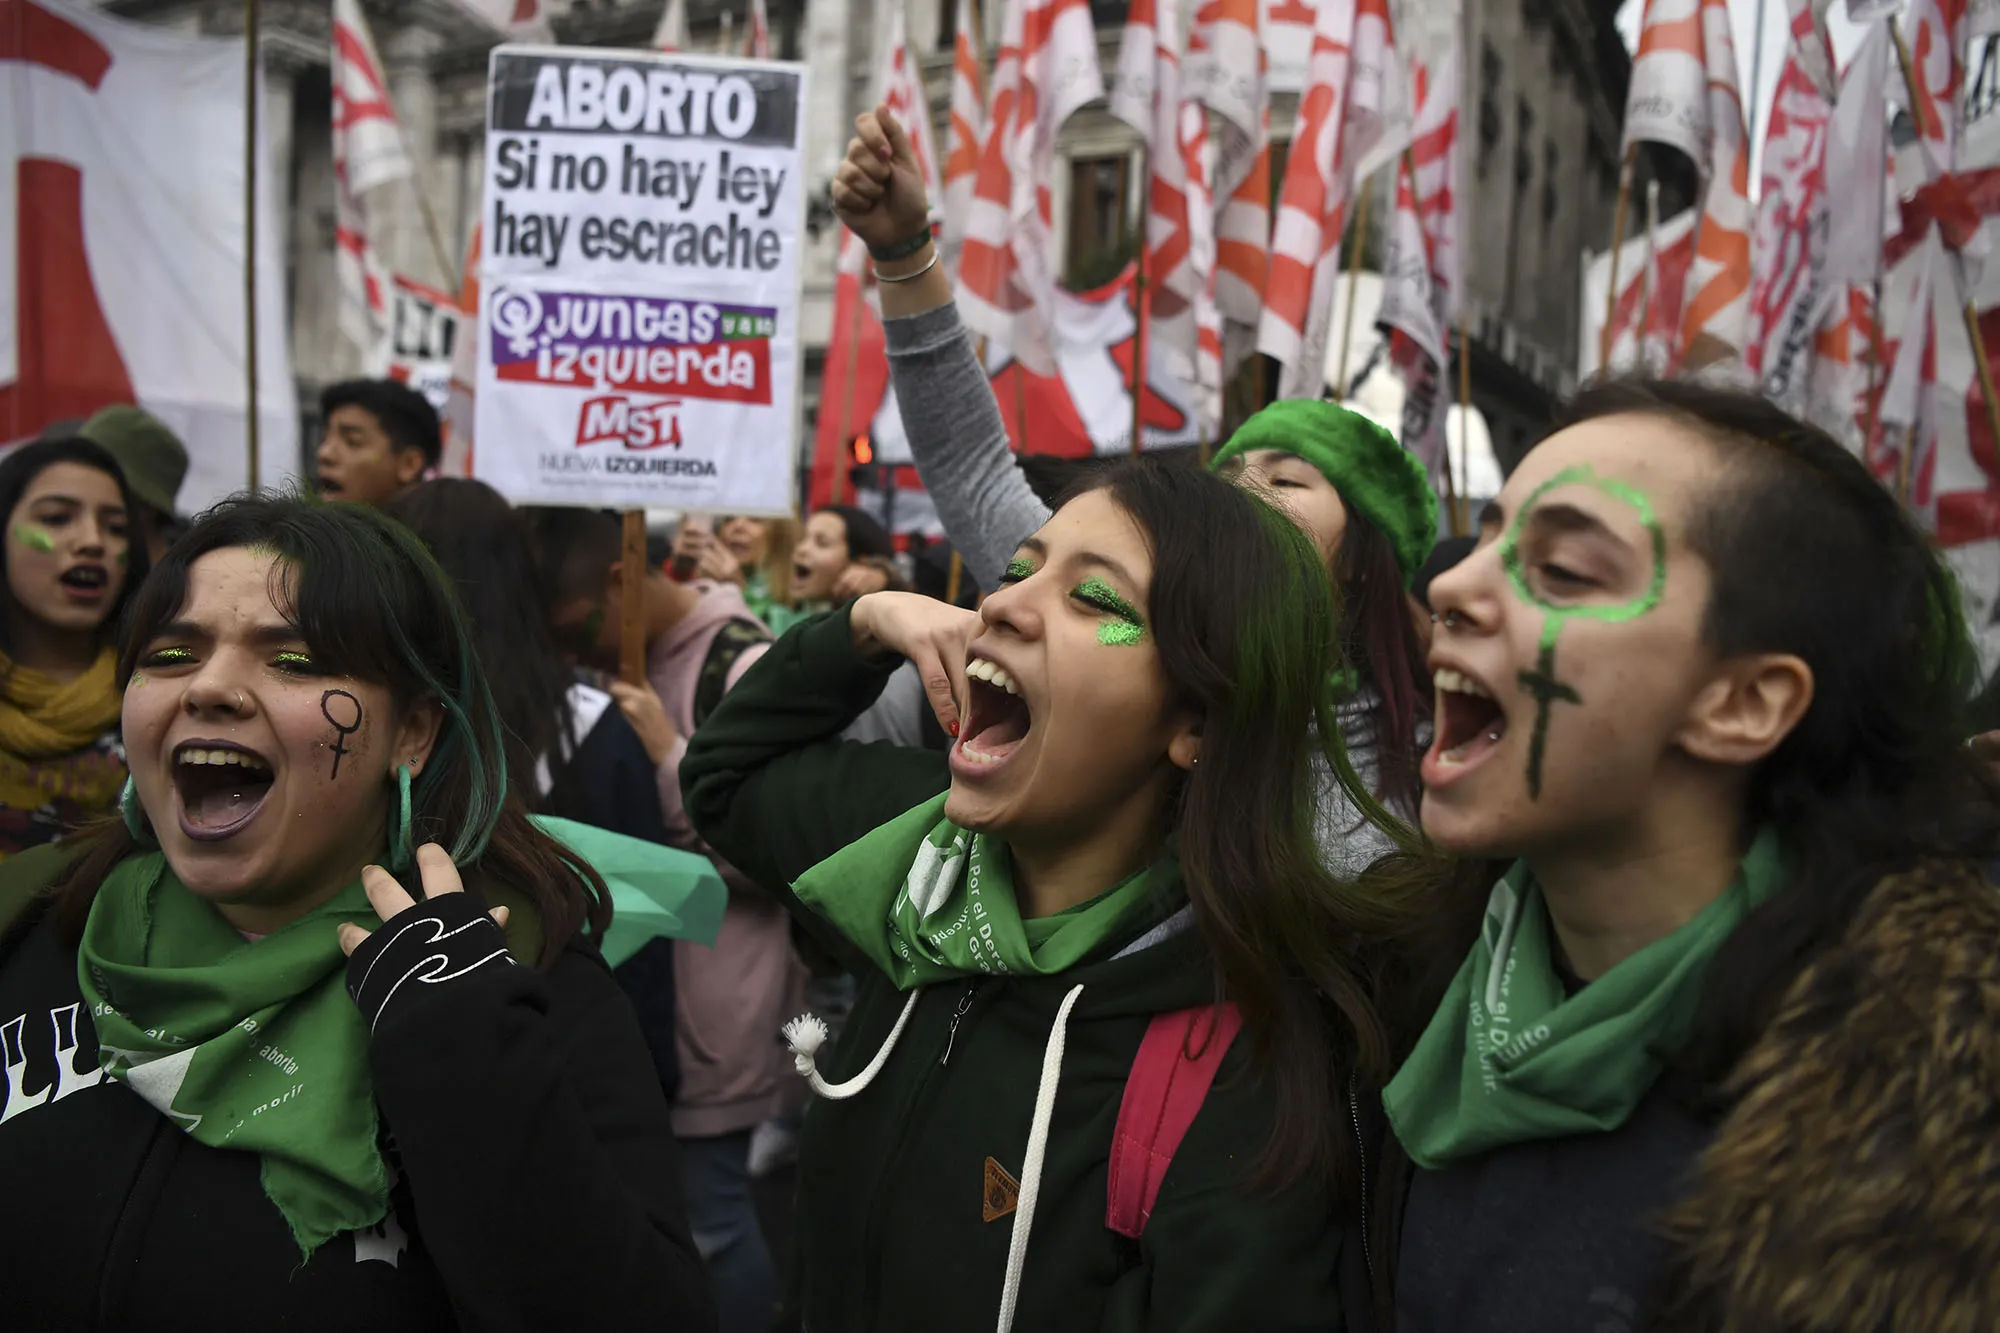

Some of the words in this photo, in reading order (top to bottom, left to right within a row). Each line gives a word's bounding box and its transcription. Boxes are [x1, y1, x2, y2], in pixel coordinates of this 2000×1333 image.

[526, 64, 757, 138] ABORTO
[495, 138, 539, 190] Si
[551, 153, 608, 193] no
[621, 144, 705, 211] hay
[718, 151, 786, 217] ley
[493, 201, 568, 267] hay
[579, 213, 781, 271] escrache
[582, 401, 680, 448] MST
[538, 452, 600, 473] NUEVA
[606, 456, 718, 477] IZQUIERDA
[973, 902, 988, 921] el
[252, 1083, 304, 1117] morir
